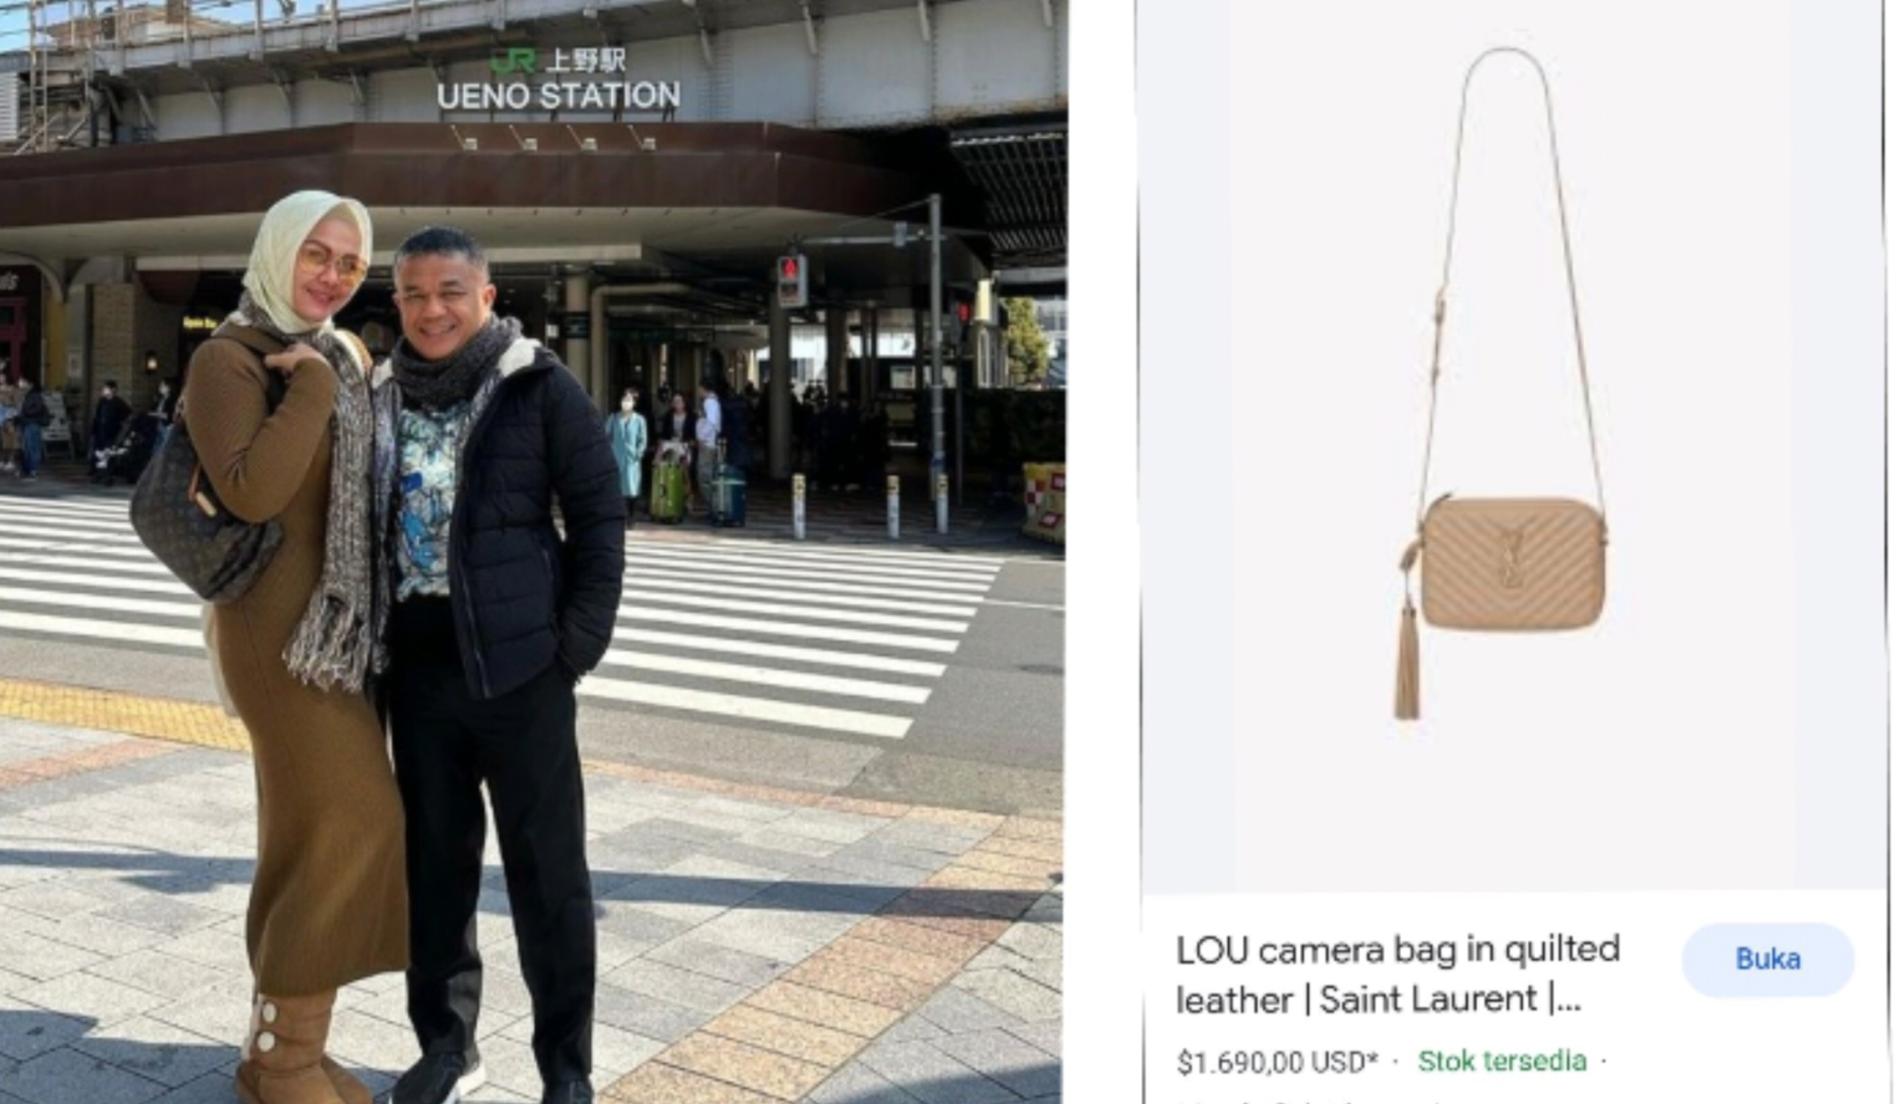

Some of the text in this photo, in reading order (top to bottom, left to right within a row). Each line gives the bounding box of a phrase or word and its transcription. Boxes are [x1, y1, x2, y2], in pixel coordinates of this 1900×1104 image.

[489, 47, 626, 73] JR 上野駅
[437, 80, 681, 110] UENO STATION
[1177, 932, 1621, 971] LOU camera bag in quilted
[1736, 946, 1802, 971] Buka
[1176, 984, 1295, 1015] leather
[1319, 984, 1403, 1015] Saint
[1412, 984, 1538, 1014] Laurent
[1177, 1048, 1305, 1077] $1.690,00
[1418, 1047, 1476, 1073] Stok
[1483, 1047, 1588, 1073] tersedia
